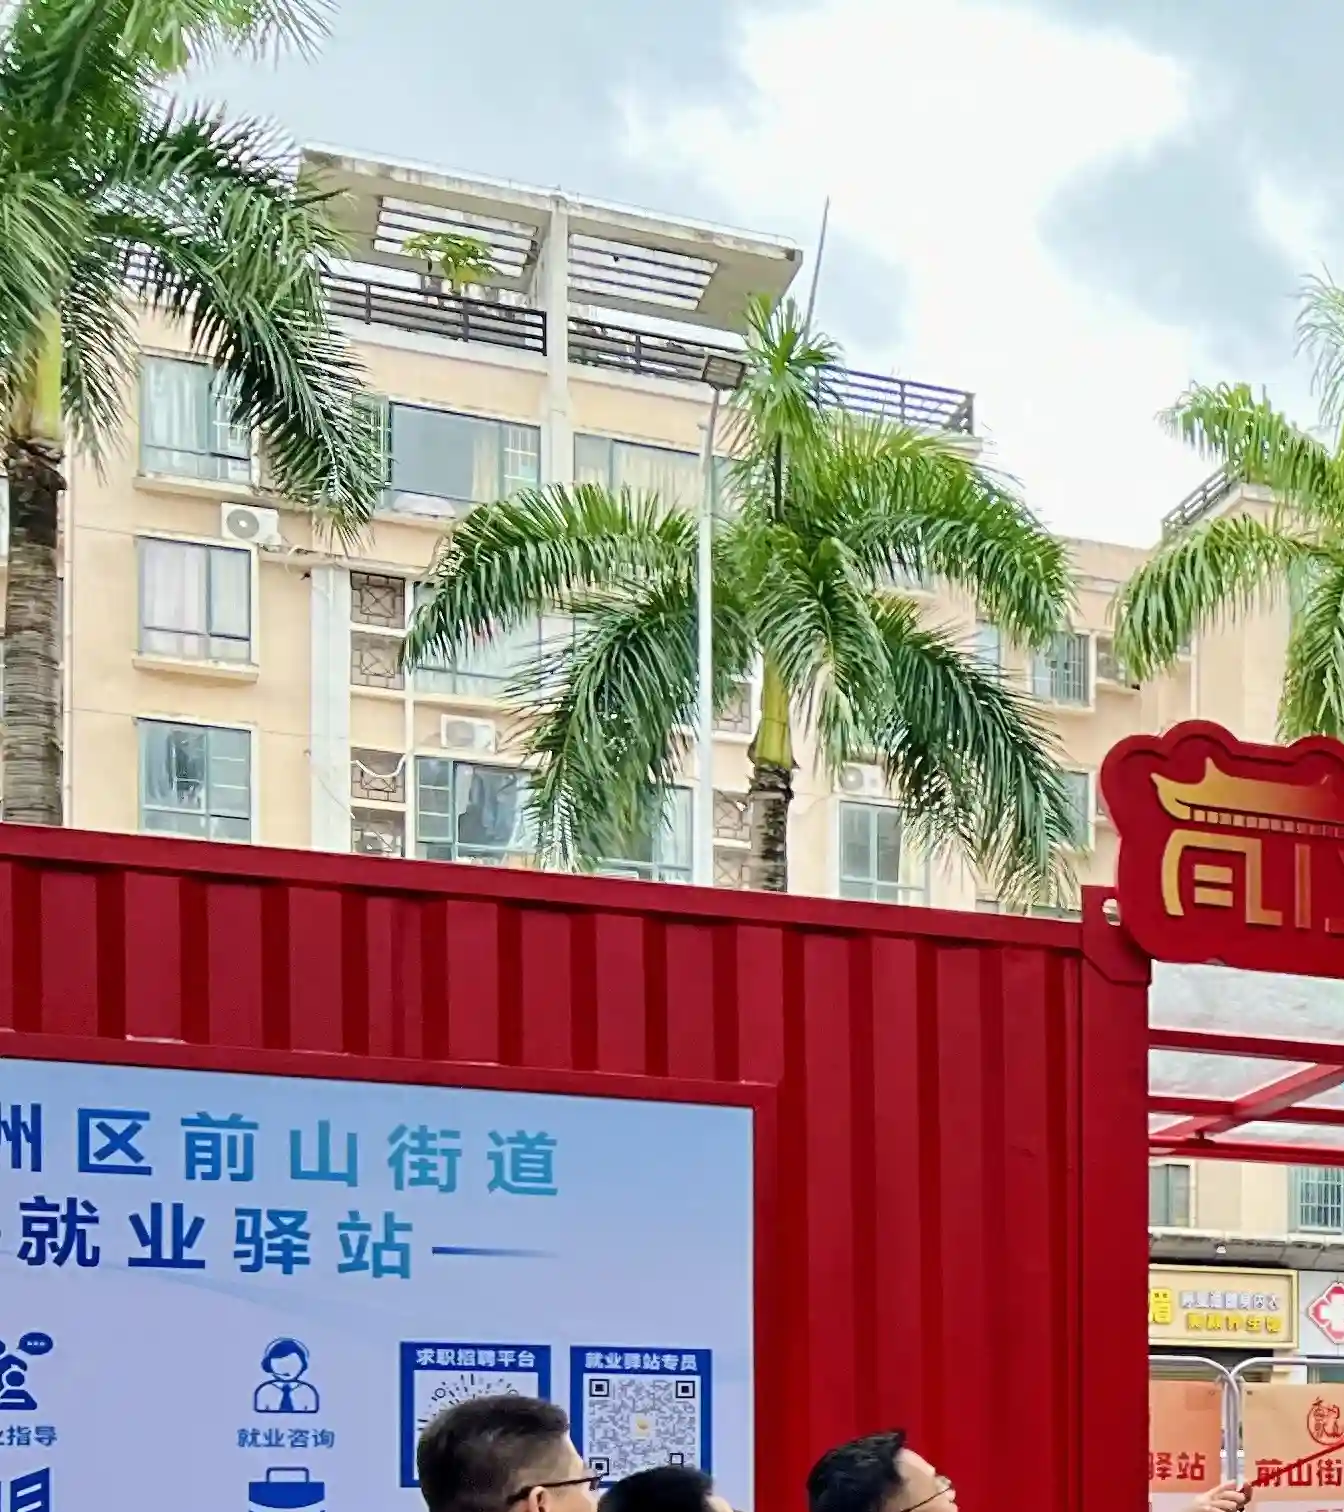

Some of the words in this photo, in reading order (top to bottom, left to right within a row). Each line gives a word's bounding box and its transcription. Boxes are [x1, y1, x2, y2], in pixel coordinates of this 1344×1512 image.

[17, 1194, 414, 1280] 就业驿站
[415, 1348, 537, 1369] 求职招聘平台
[584, 1351, 699, 1372] 就业驿站专员
[0, 1425, 58, 1447] 指导
[236, 1428, 336, 1449] 就业咨询
